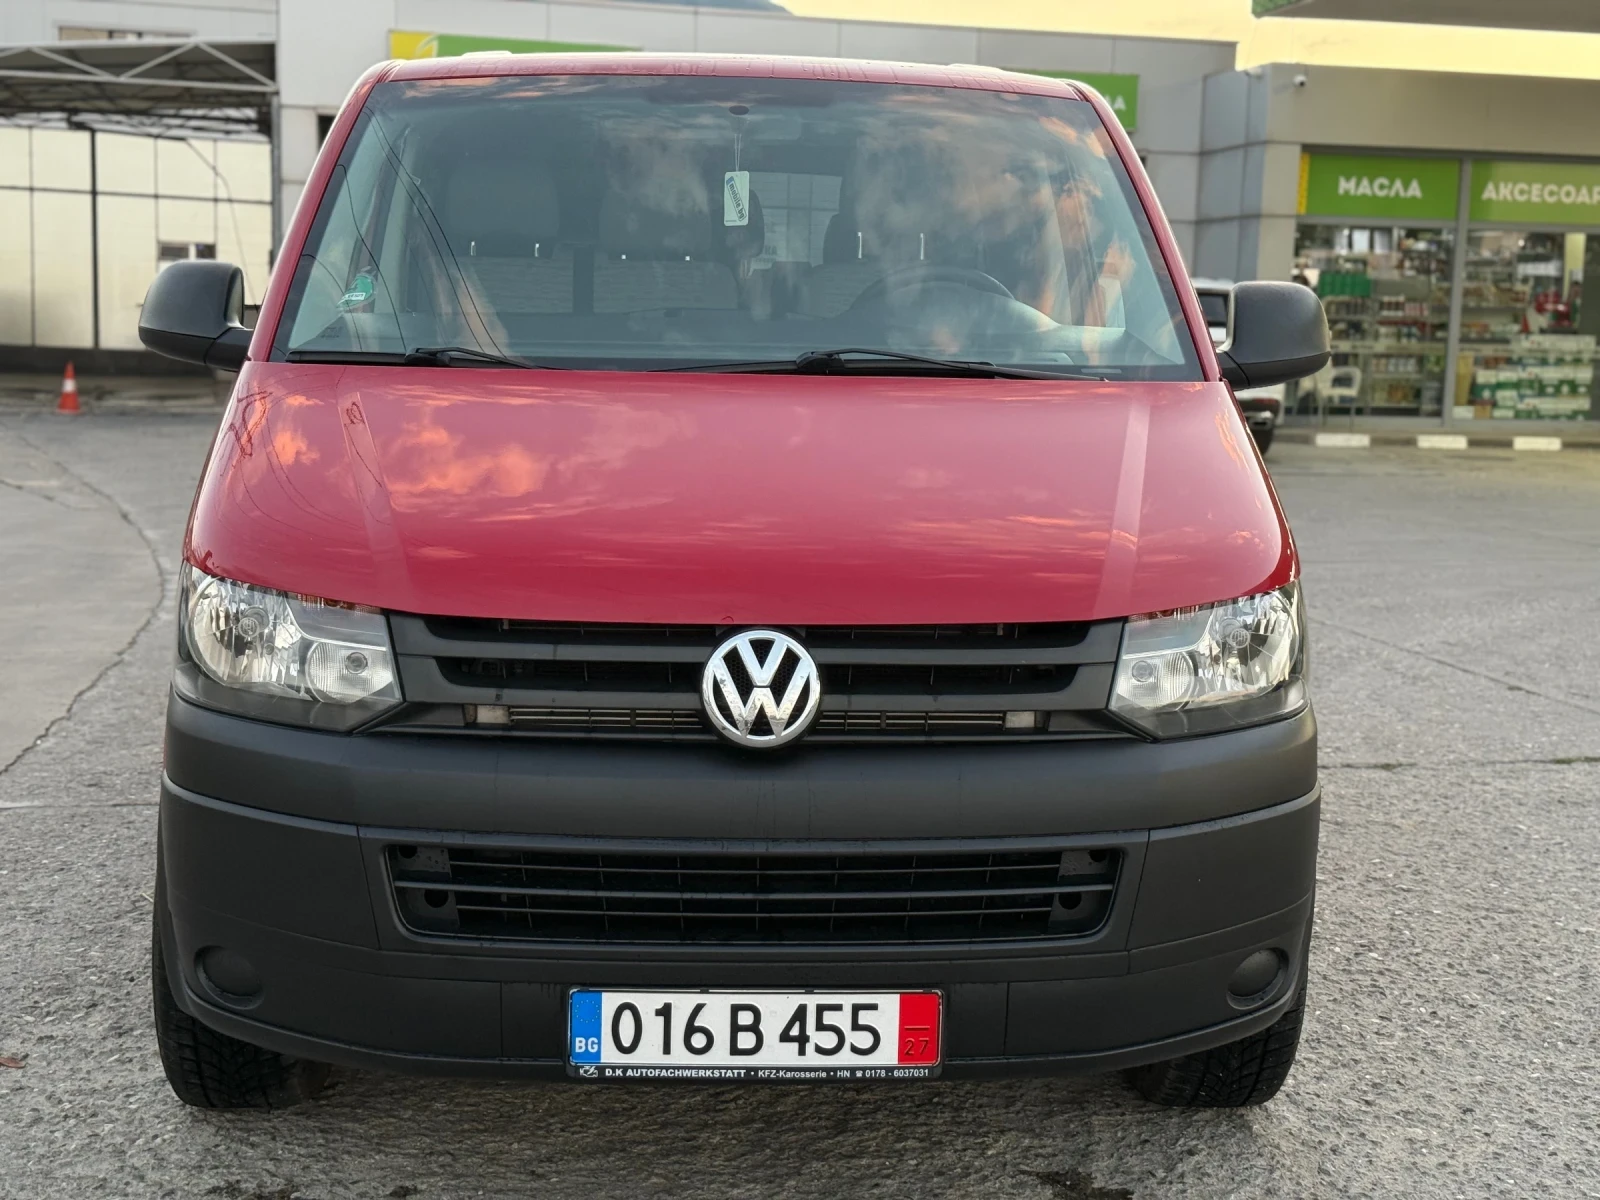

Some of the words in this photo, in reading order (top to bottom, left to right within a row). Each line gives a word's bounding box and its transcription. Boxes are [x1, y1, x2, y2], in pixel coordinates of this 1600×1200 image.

[1338, 176, 1422, 198] МАСЛА
[729, 183, 746, 219] mobile.bg
[611, 1002, 715, 1055] 016
[729, 1003, 764, 1056] B
[779, 1003, 881, 1056] 455
[575, 1038, 598, 1053] BG
[904, 1039, 929, 1056] 27
[605, 1068, 624, 1077] D.K
[626, 1068, 746, 1078] AUTOFACHWERKSTATT
[758, 1069, 827, 1079] KFZ-Karosserie
[837, 1069, 850, 1078] HN
[865, 1068, 886, 1078] 0178
[893, 1068, 929, 1077] 6037031
